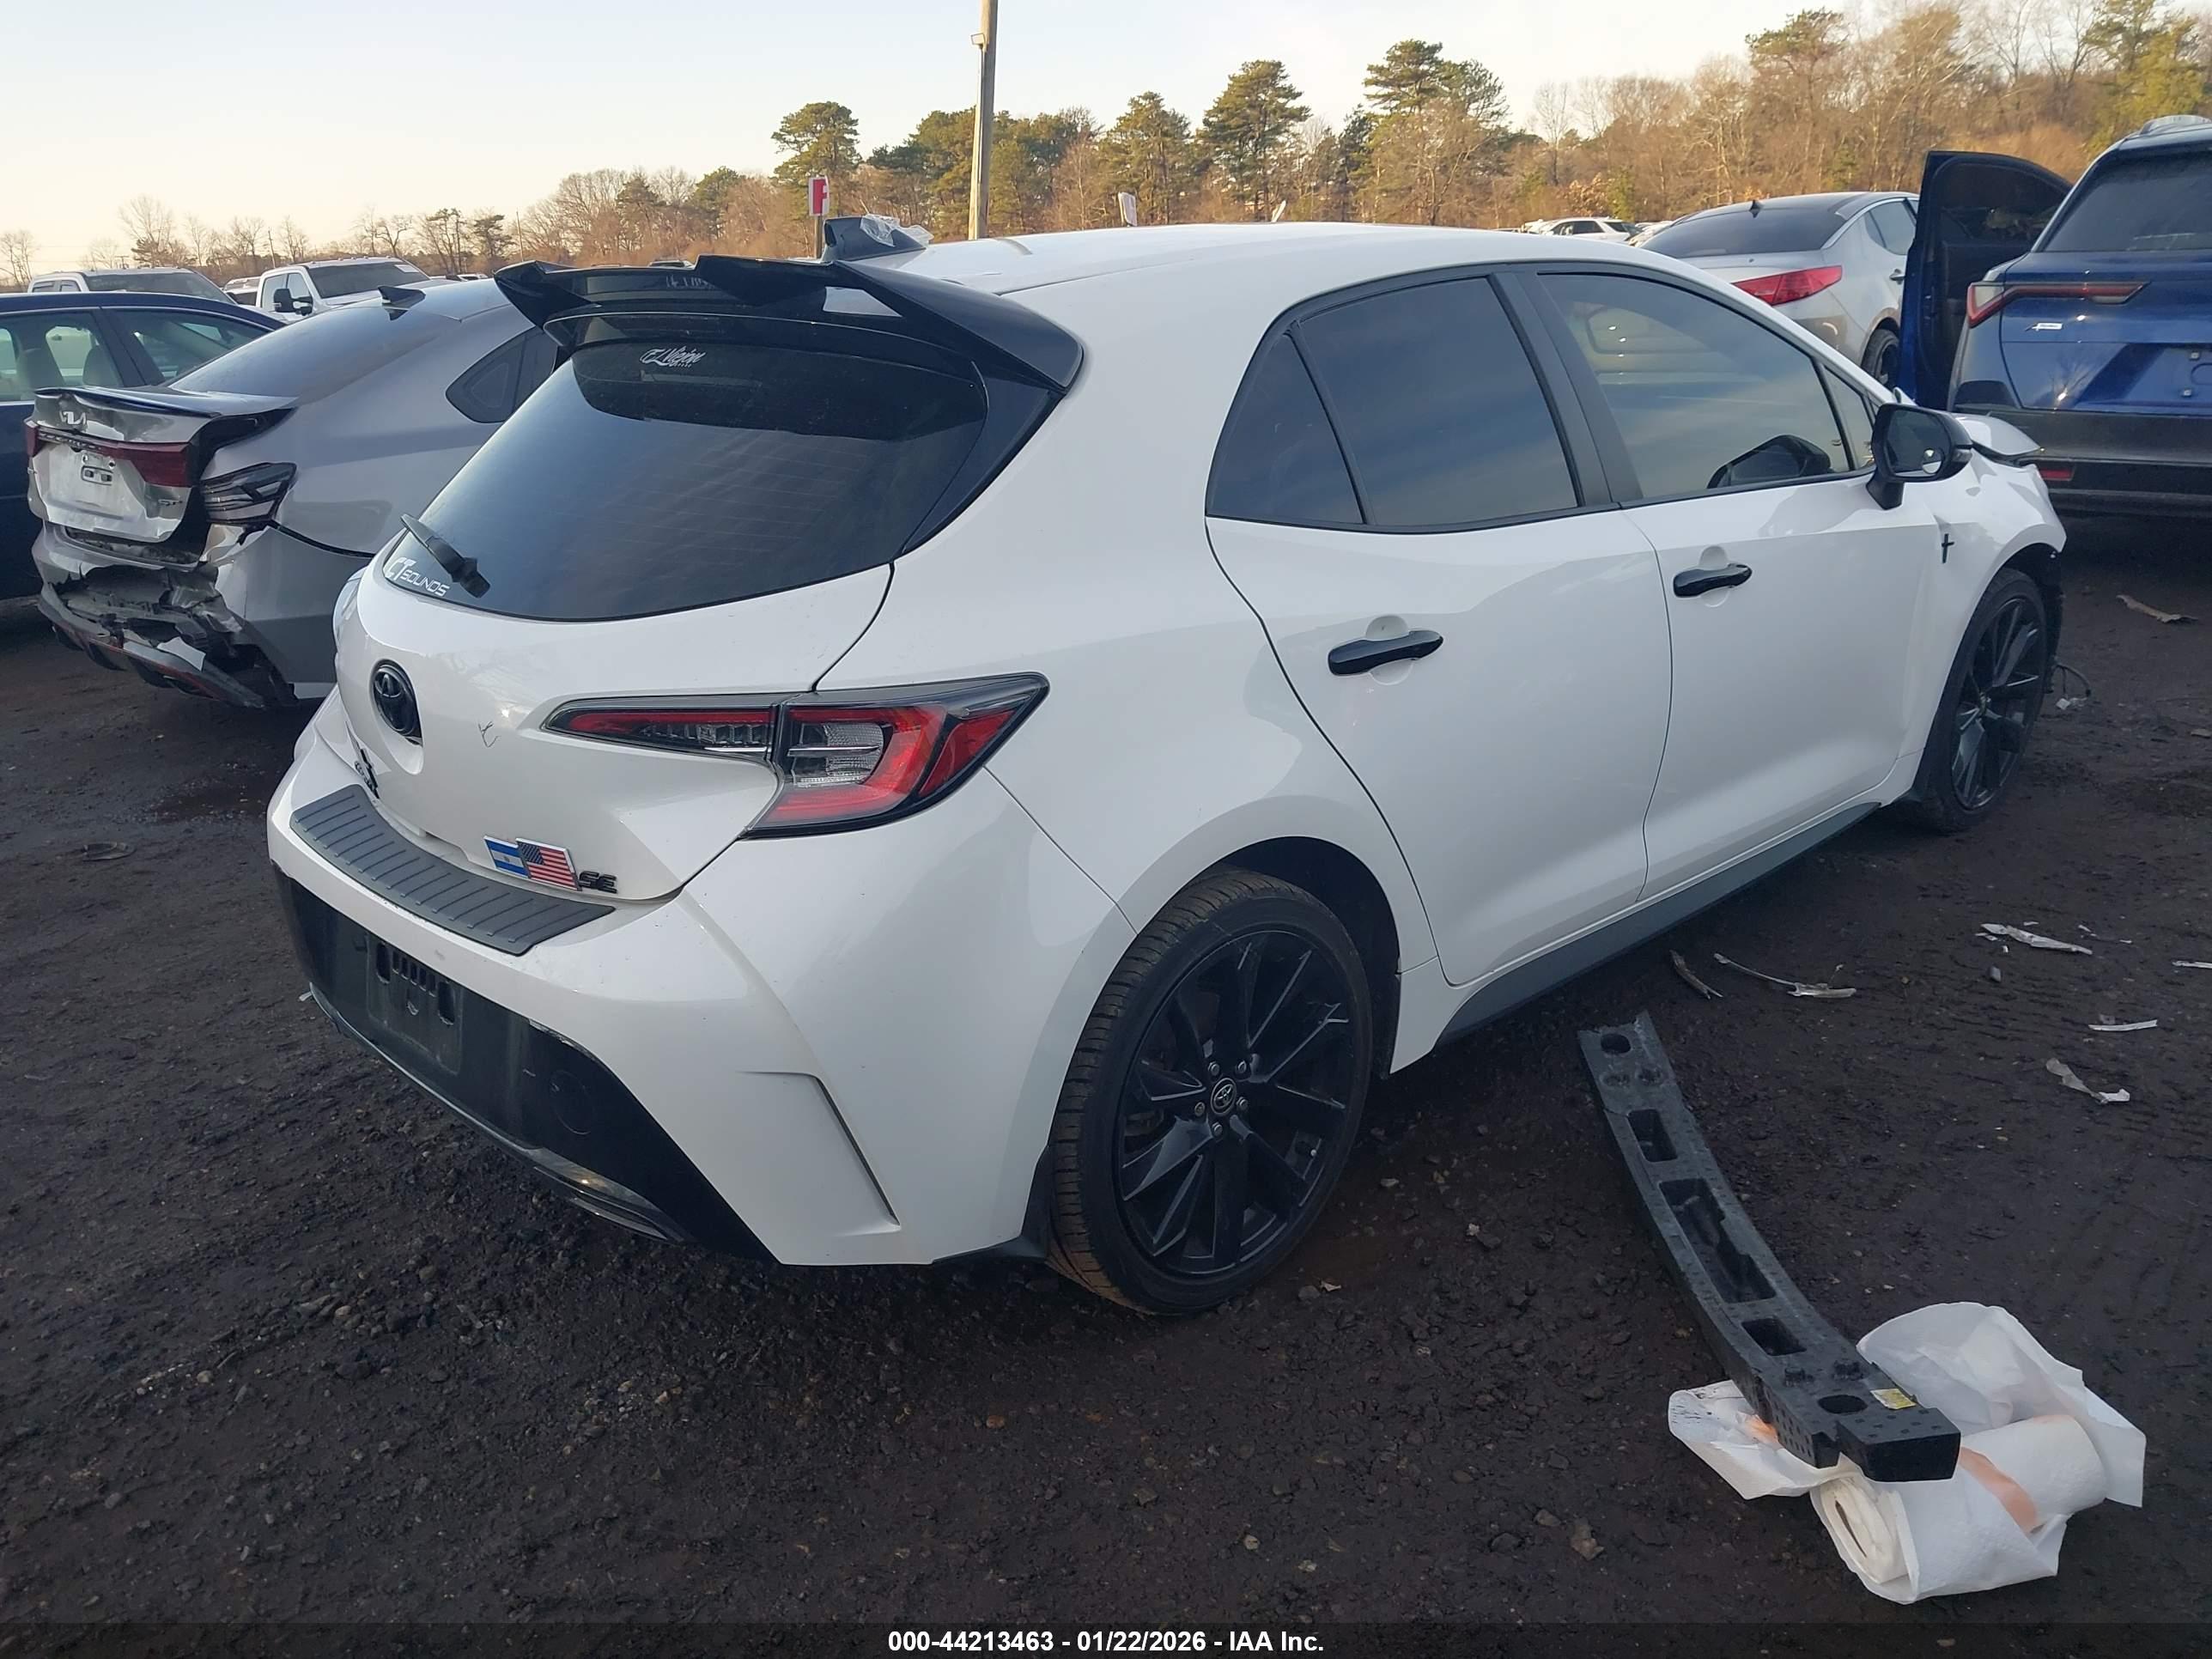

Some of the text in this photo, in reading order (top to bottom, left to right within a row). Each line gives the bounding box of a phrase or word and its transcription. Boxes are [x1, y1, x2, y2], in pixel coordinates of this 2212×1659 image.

[58, 410, 87, 425] KIA
[384, 556, 450, 597] CT SOUNDS
[578, 871, 617, 894] SE
